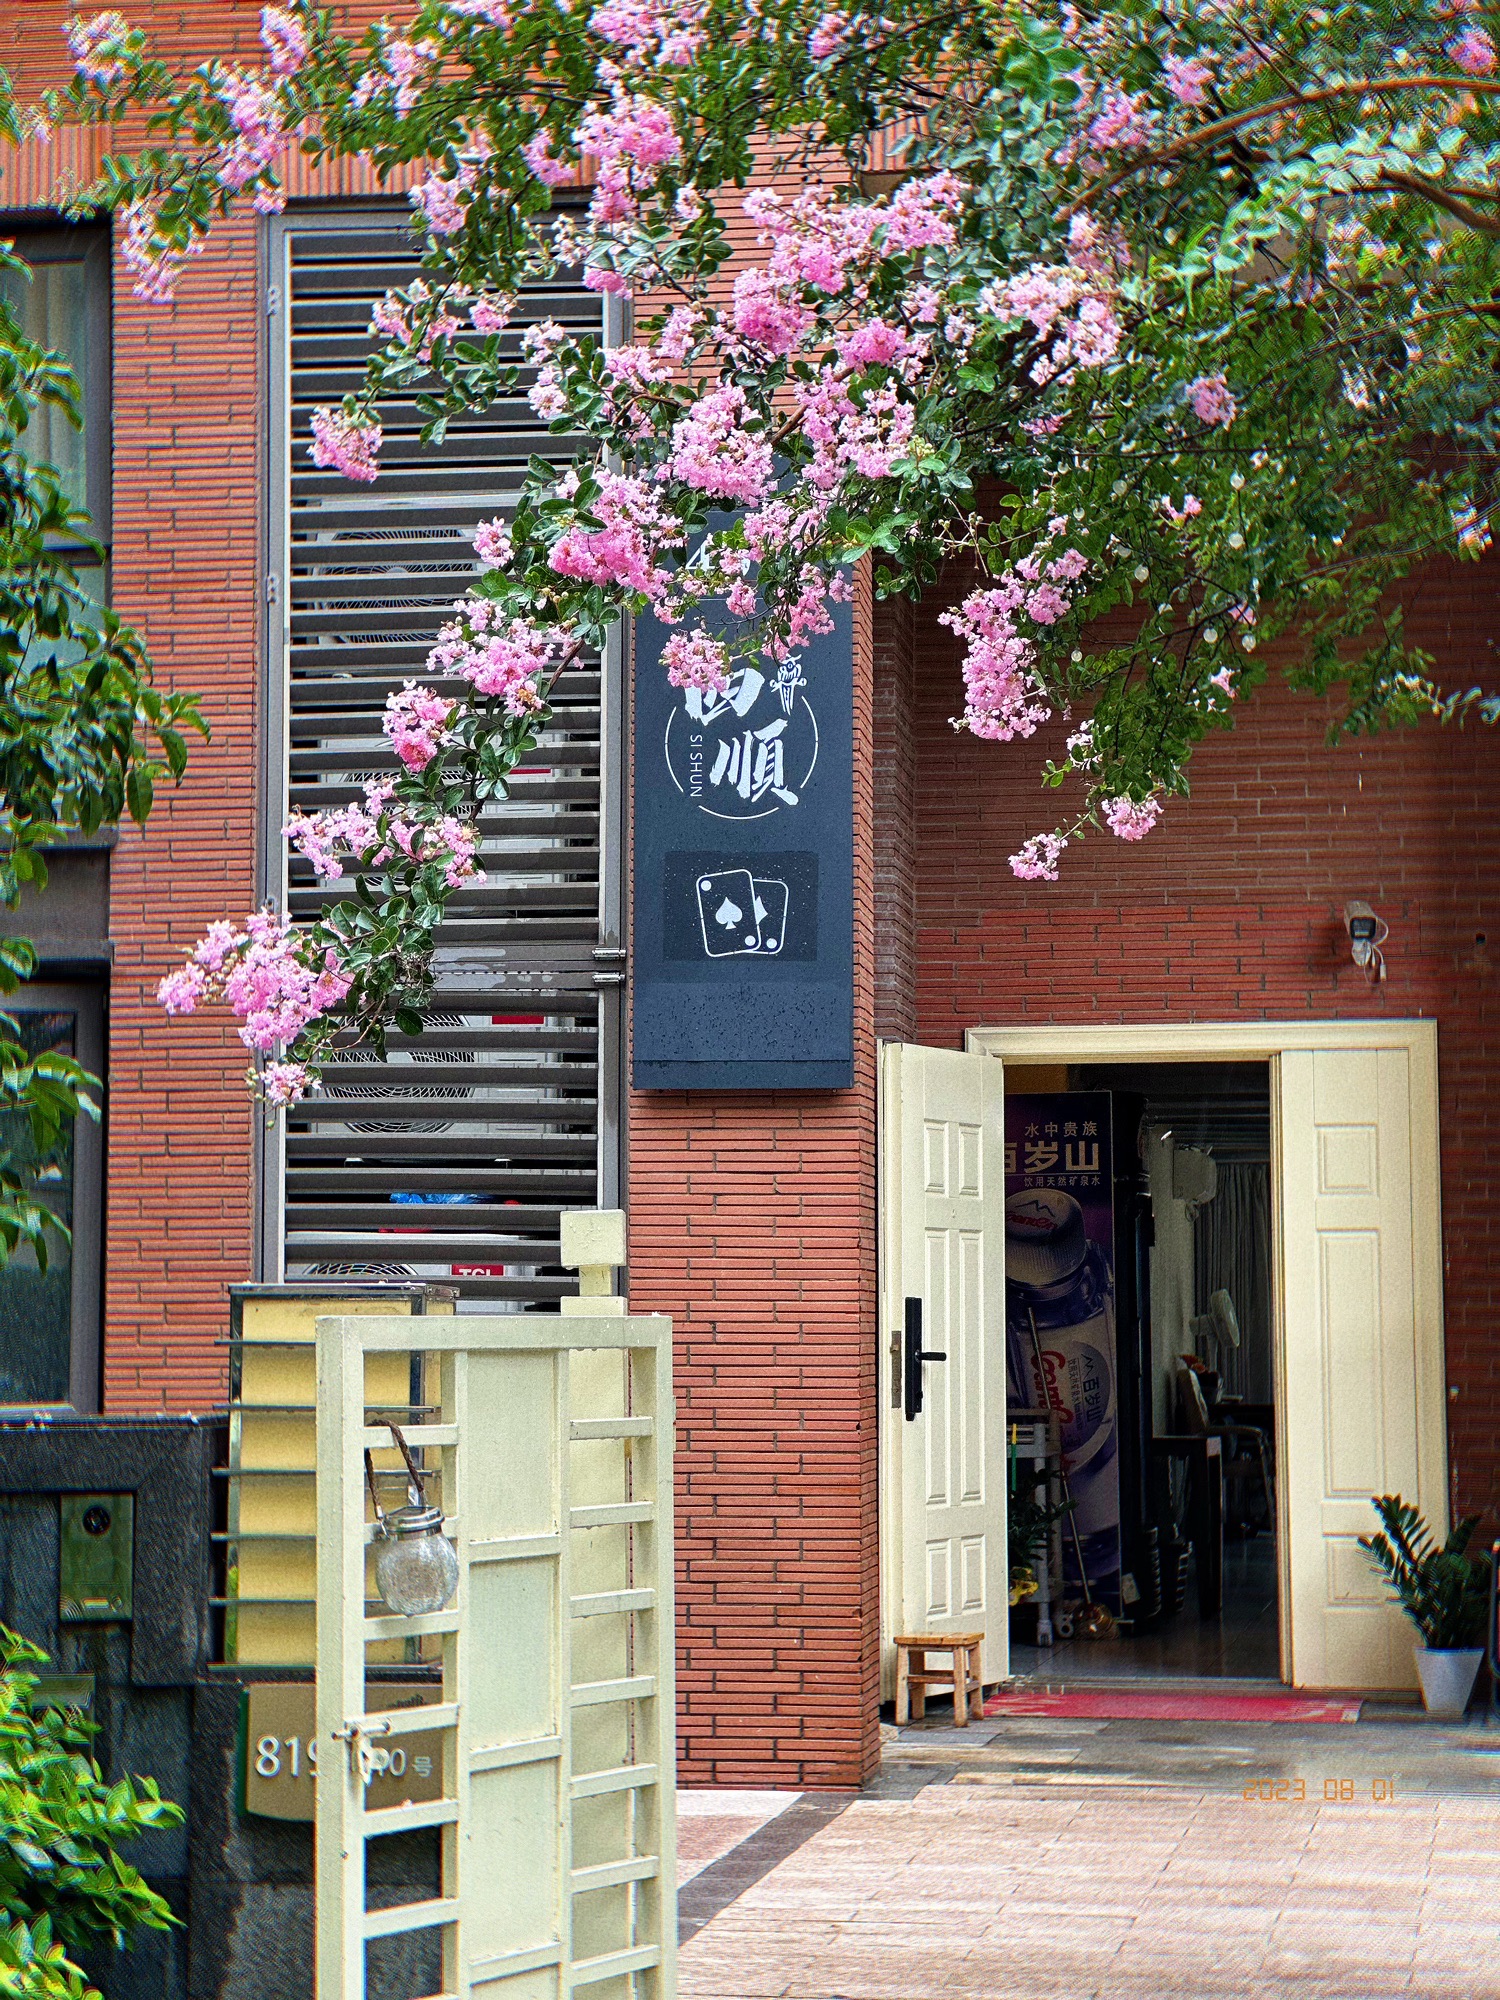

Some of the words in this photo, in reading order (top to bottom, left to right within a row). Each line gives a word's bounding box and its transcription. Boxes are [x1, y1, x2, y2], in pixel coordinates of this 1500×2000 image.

[1024, 1120, 1098, 1138] 水中贵族
[1023, 1175, 1101, 1188] 饮用天然矿泉水
[1082, 1377, 1102, 1423] 百岁山
